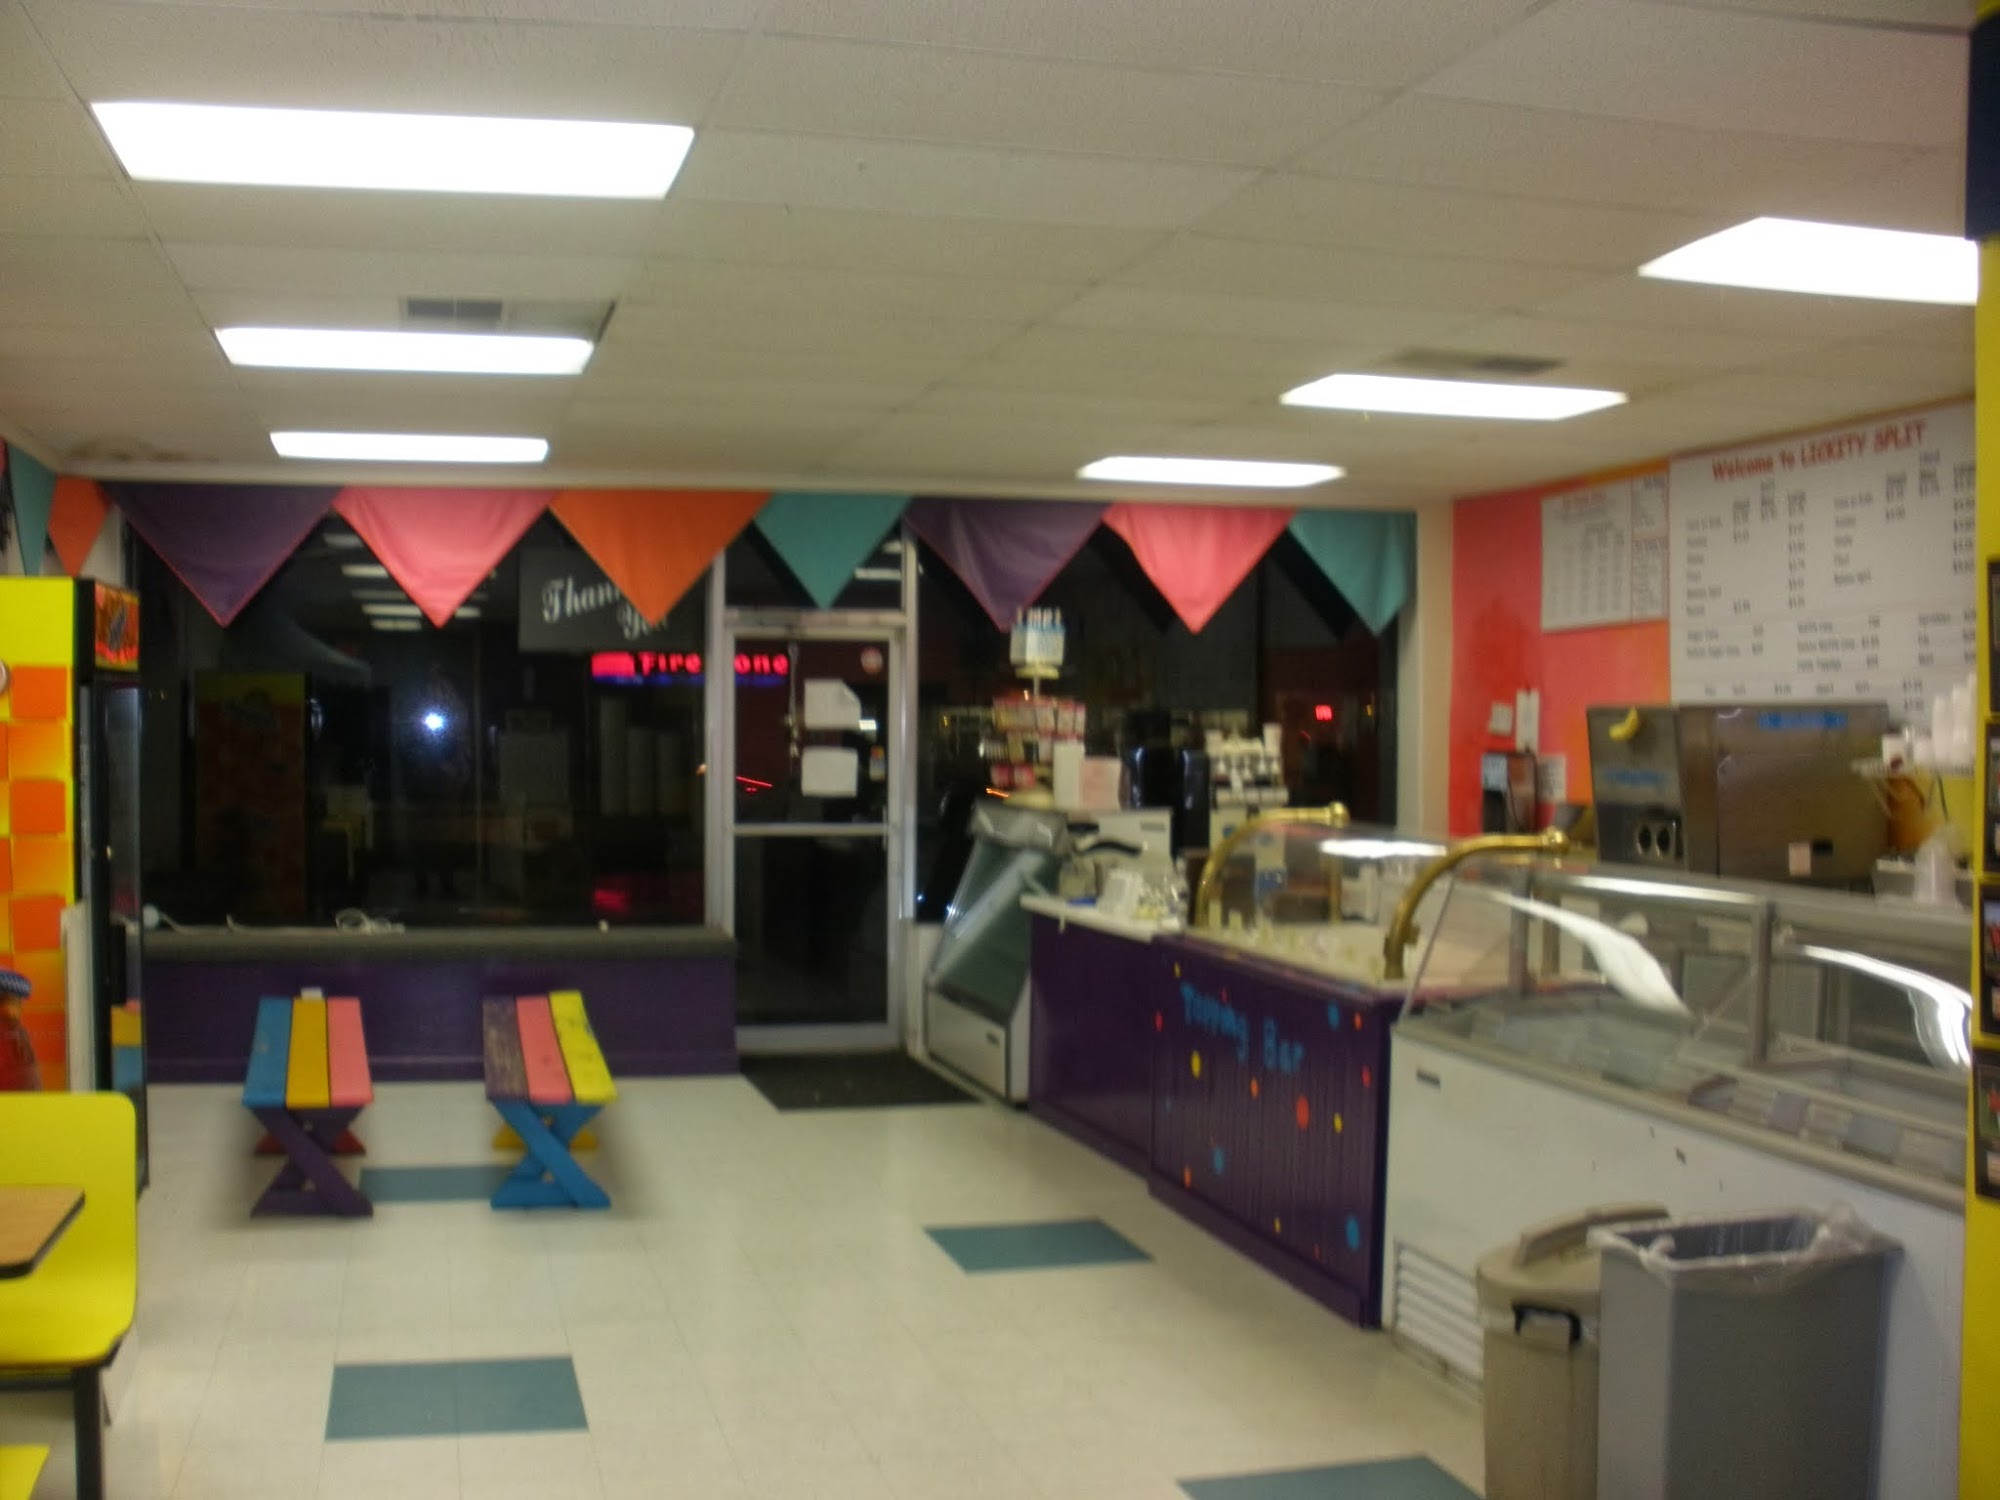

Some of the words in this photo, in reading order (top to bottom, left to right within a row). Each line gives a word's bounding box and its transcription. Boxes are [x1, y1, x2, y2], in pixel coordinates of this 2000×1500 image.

[1712, 456, 1774, 482] Welcome
[1873, 418, 1926, 454] SPLIT
[542, 577, 620, 623] Than
[638, 651, 788, 677] Fireone
[1262, 1016, 1306, 1073] Bar
